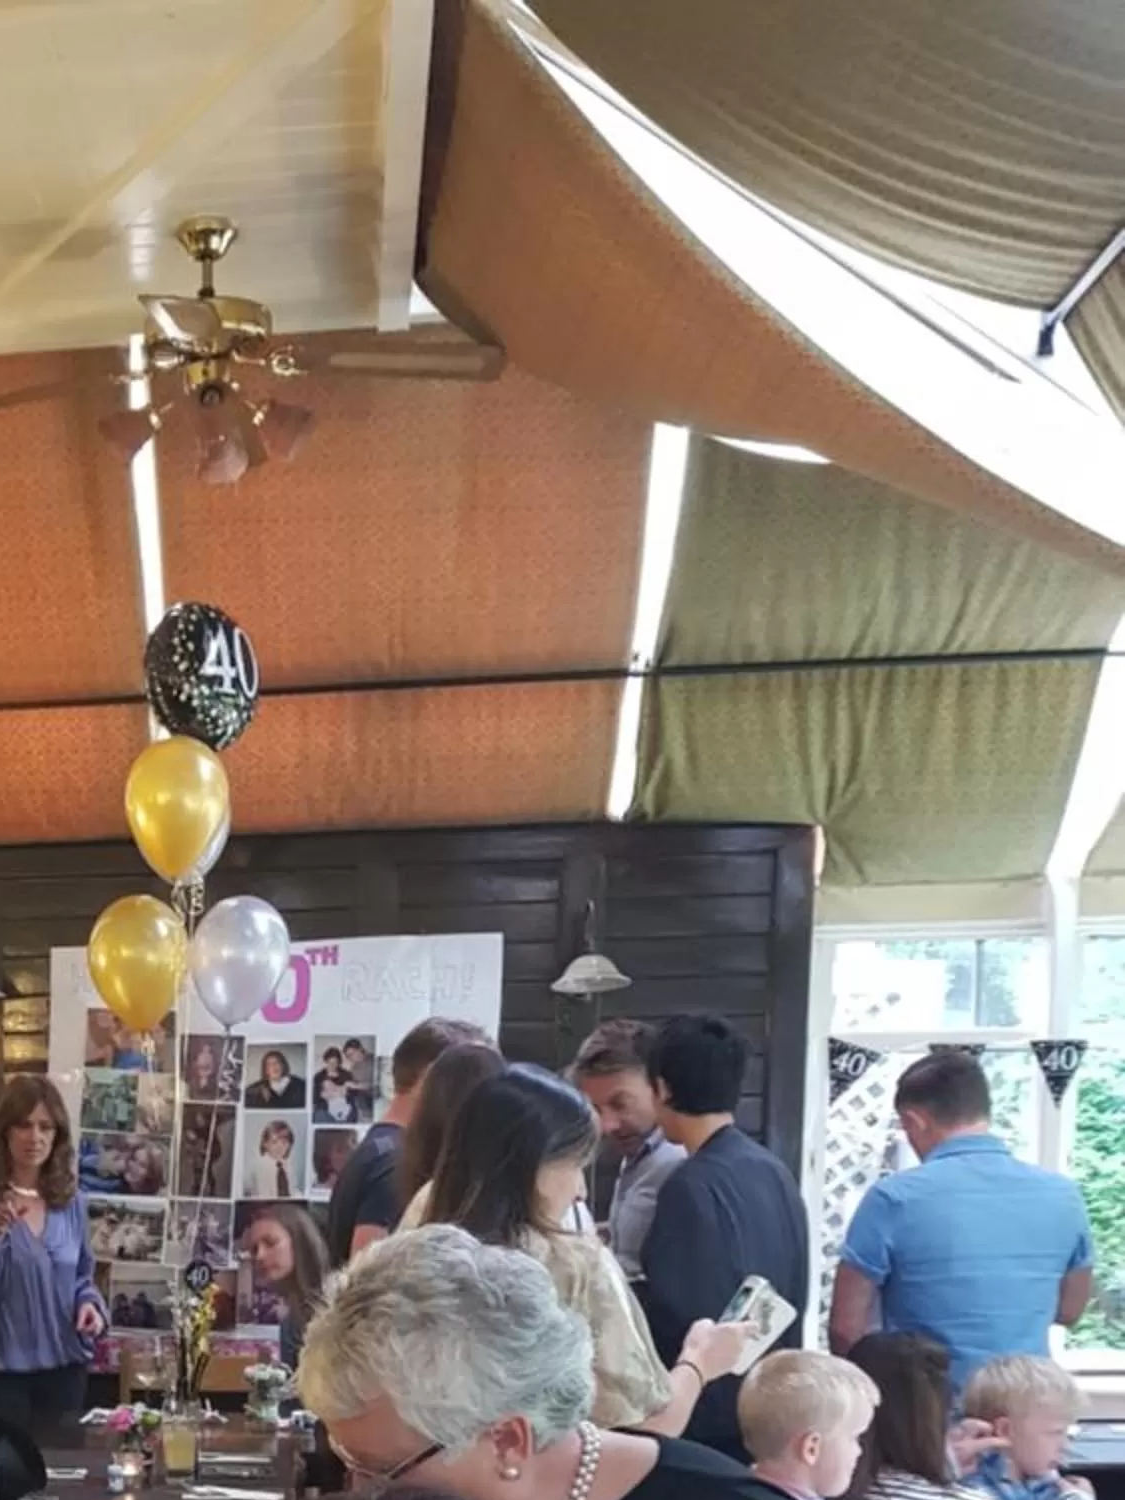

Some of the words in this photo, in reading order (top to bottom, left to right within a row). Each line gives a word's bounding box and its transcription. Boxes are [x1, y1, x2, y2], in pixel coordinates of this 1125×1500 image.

[198, 623, 259, 699] 40
[832, 1051, 867, 1077] 40
[1043, 1045, 1078, 1071] 40
[187, 1266, 210, 1288] 40
